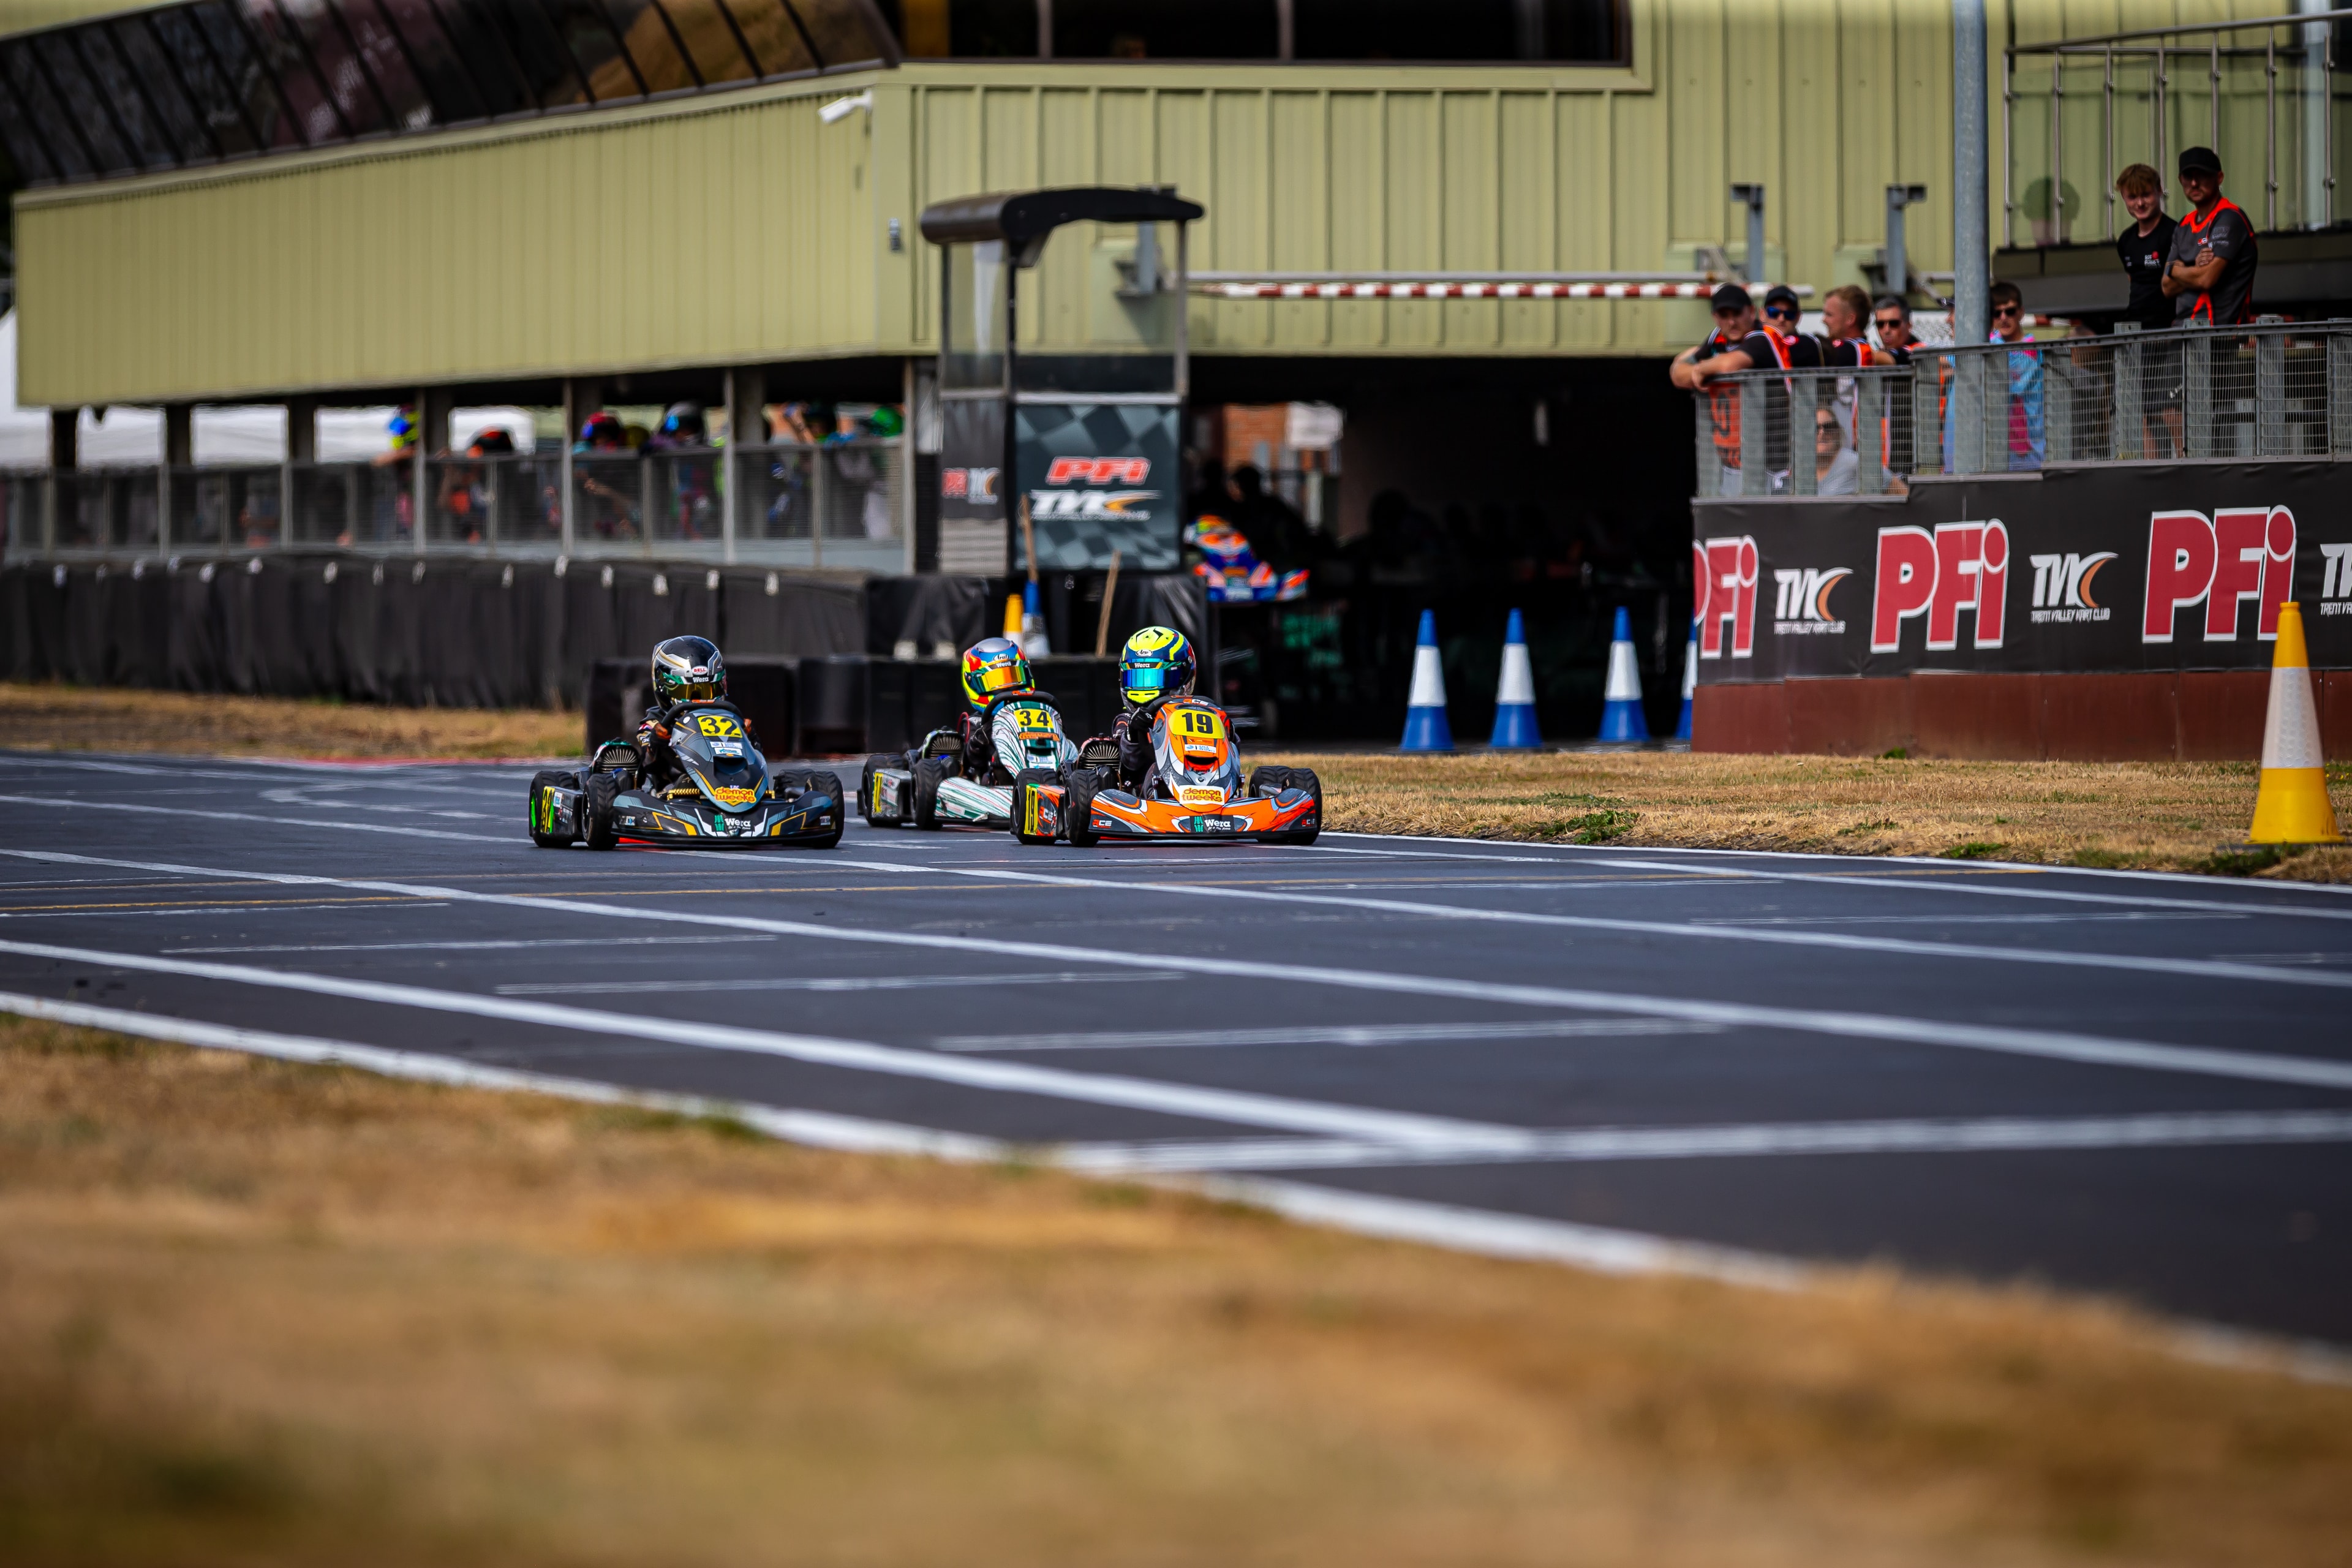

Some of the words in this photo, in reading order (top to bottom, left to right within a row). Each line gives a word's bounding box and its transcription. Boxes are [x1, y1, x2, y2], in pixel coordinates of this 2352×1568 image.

[2143, 505, 2297, 643] PFi
[1870, 518, 2009, 653] PFi
[1019, 710, 1049, 726] 34
[1182, 712, 1213, 734] 19
[701, 717, 741, 736] 32
[715, 794, 756, 802] tweeks
[717, 786, 753, 795] demon
[1183, 788, 1221, 796] demon
[725, 818, 751, 827] Wera
